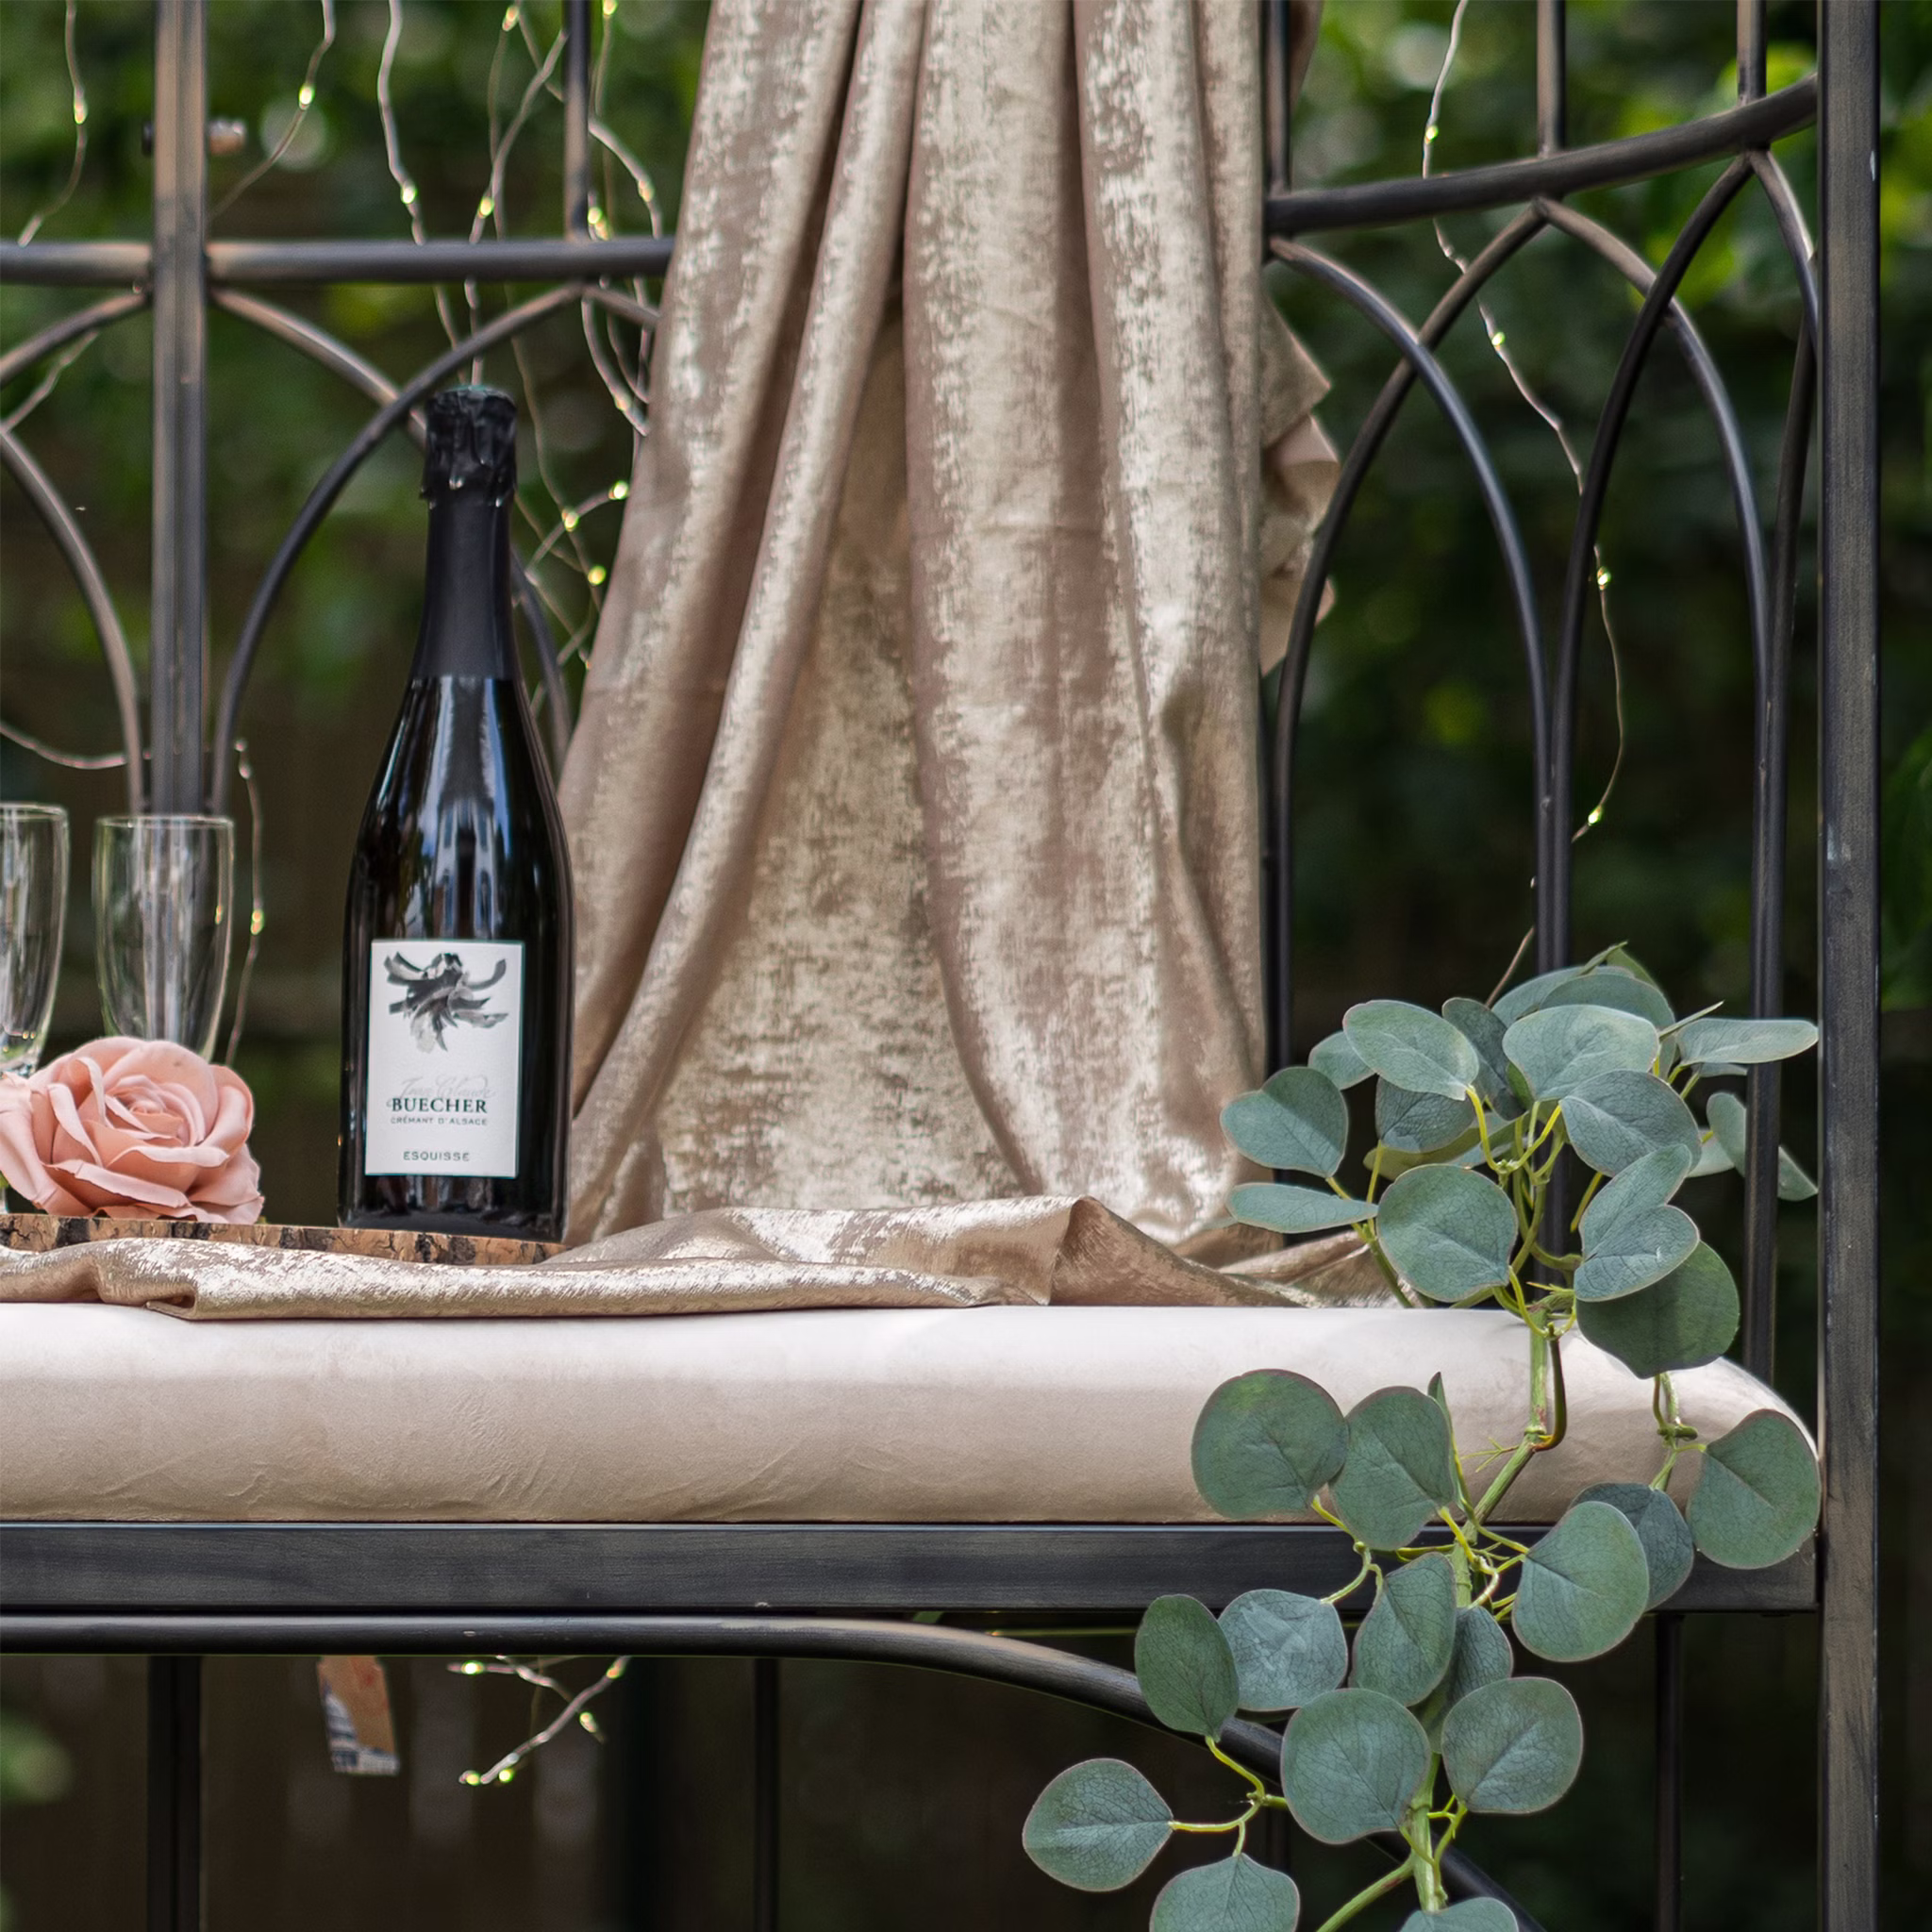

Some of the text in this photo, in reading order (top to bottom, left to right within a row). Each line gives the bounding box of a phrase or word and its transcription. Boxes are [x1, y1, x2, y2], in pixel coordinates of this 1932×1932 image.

[391, 1097, 488, 1113] BUECHER
[391, 1115, 488, 1125] CRÉMANT D'ALSACE
[403, 1151, 470, 1161] ESQUISSE
